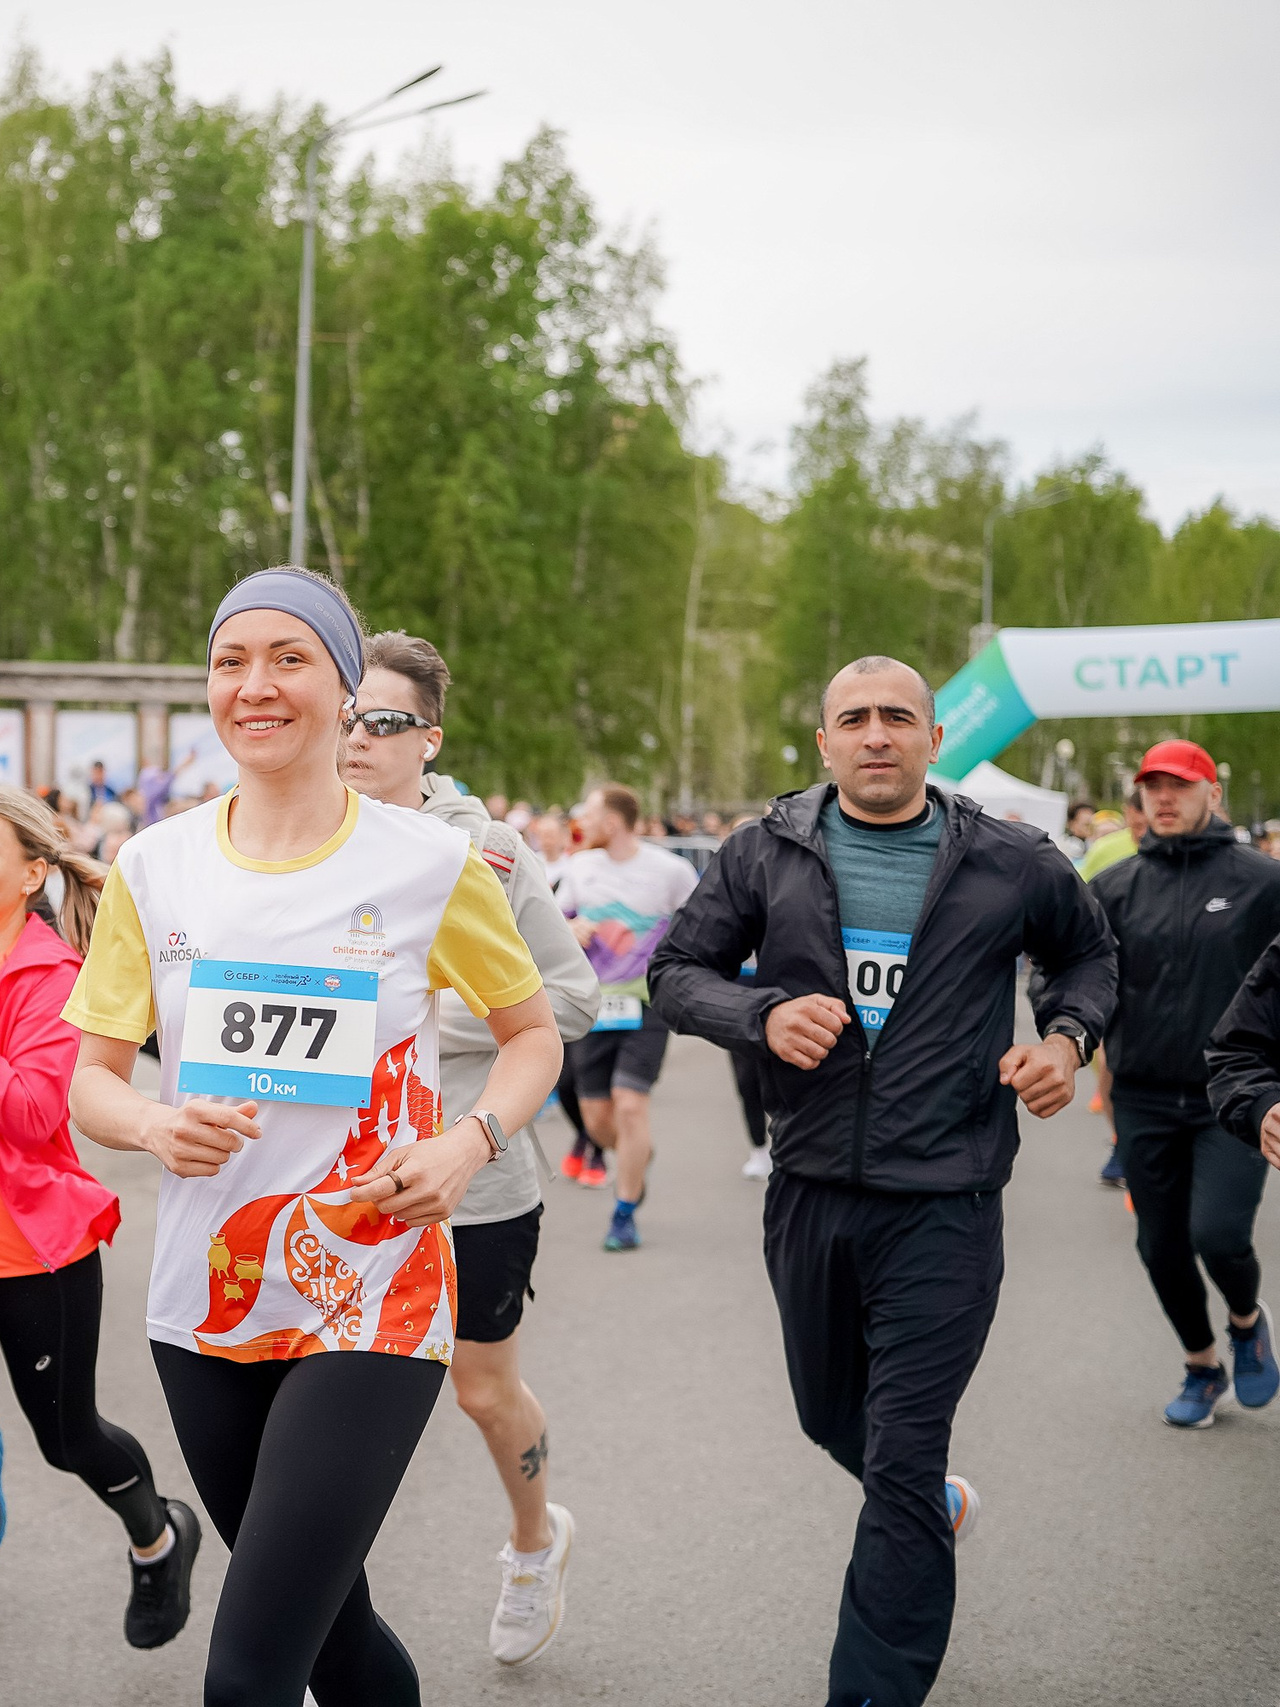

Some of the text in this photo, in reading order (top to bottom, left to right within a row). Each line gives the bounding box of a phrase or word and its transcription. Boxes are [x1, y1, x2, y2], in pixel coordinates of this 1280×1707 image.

[1074, 651, 1239, 690] СТАРТ
[159, 948, 201, 963] ALROSA
[333, 946, 396, 957] Children of Asia
[236, 972, 260, 981] СБЕР
[221, 1001, 337, 1060] 877
